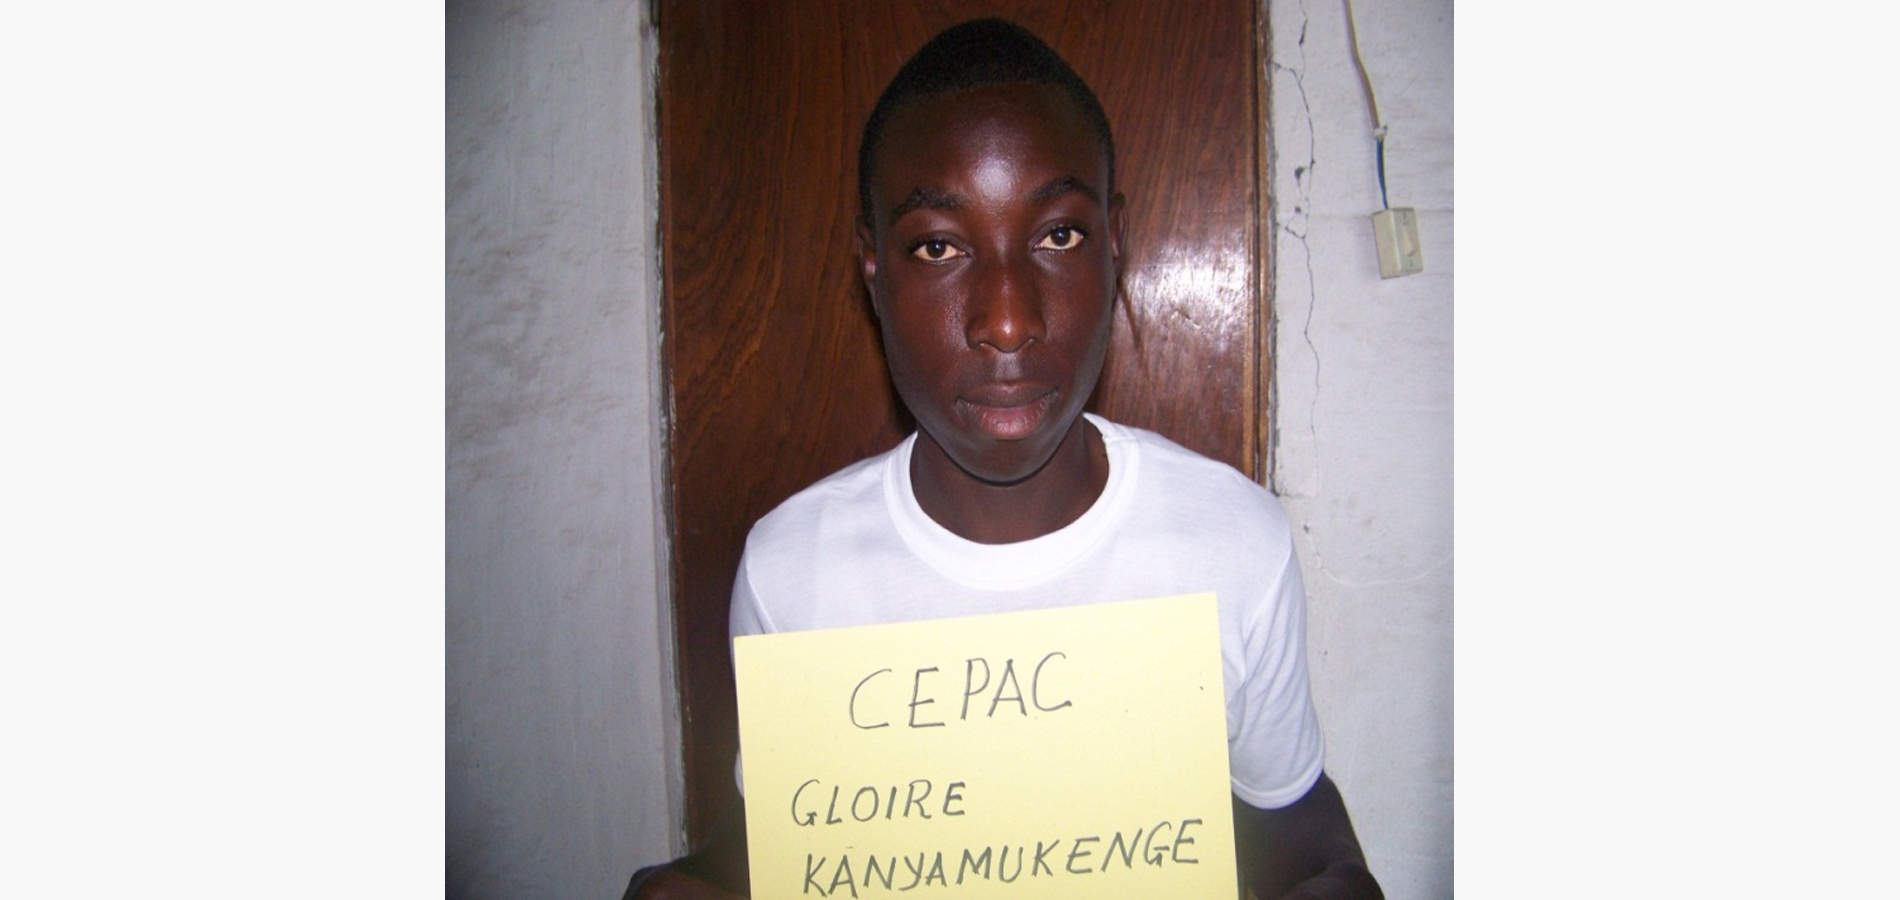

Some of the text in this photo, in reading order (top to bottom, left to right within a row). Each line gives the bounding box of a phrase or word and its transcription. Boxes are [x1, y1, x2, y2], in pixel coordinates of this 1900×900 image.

[849, 652, 1072, 729] CEPAC
[791, 779, 966, 827] GLOIRE
[803, 818, 1203, 899] KANYAMUKENGE
